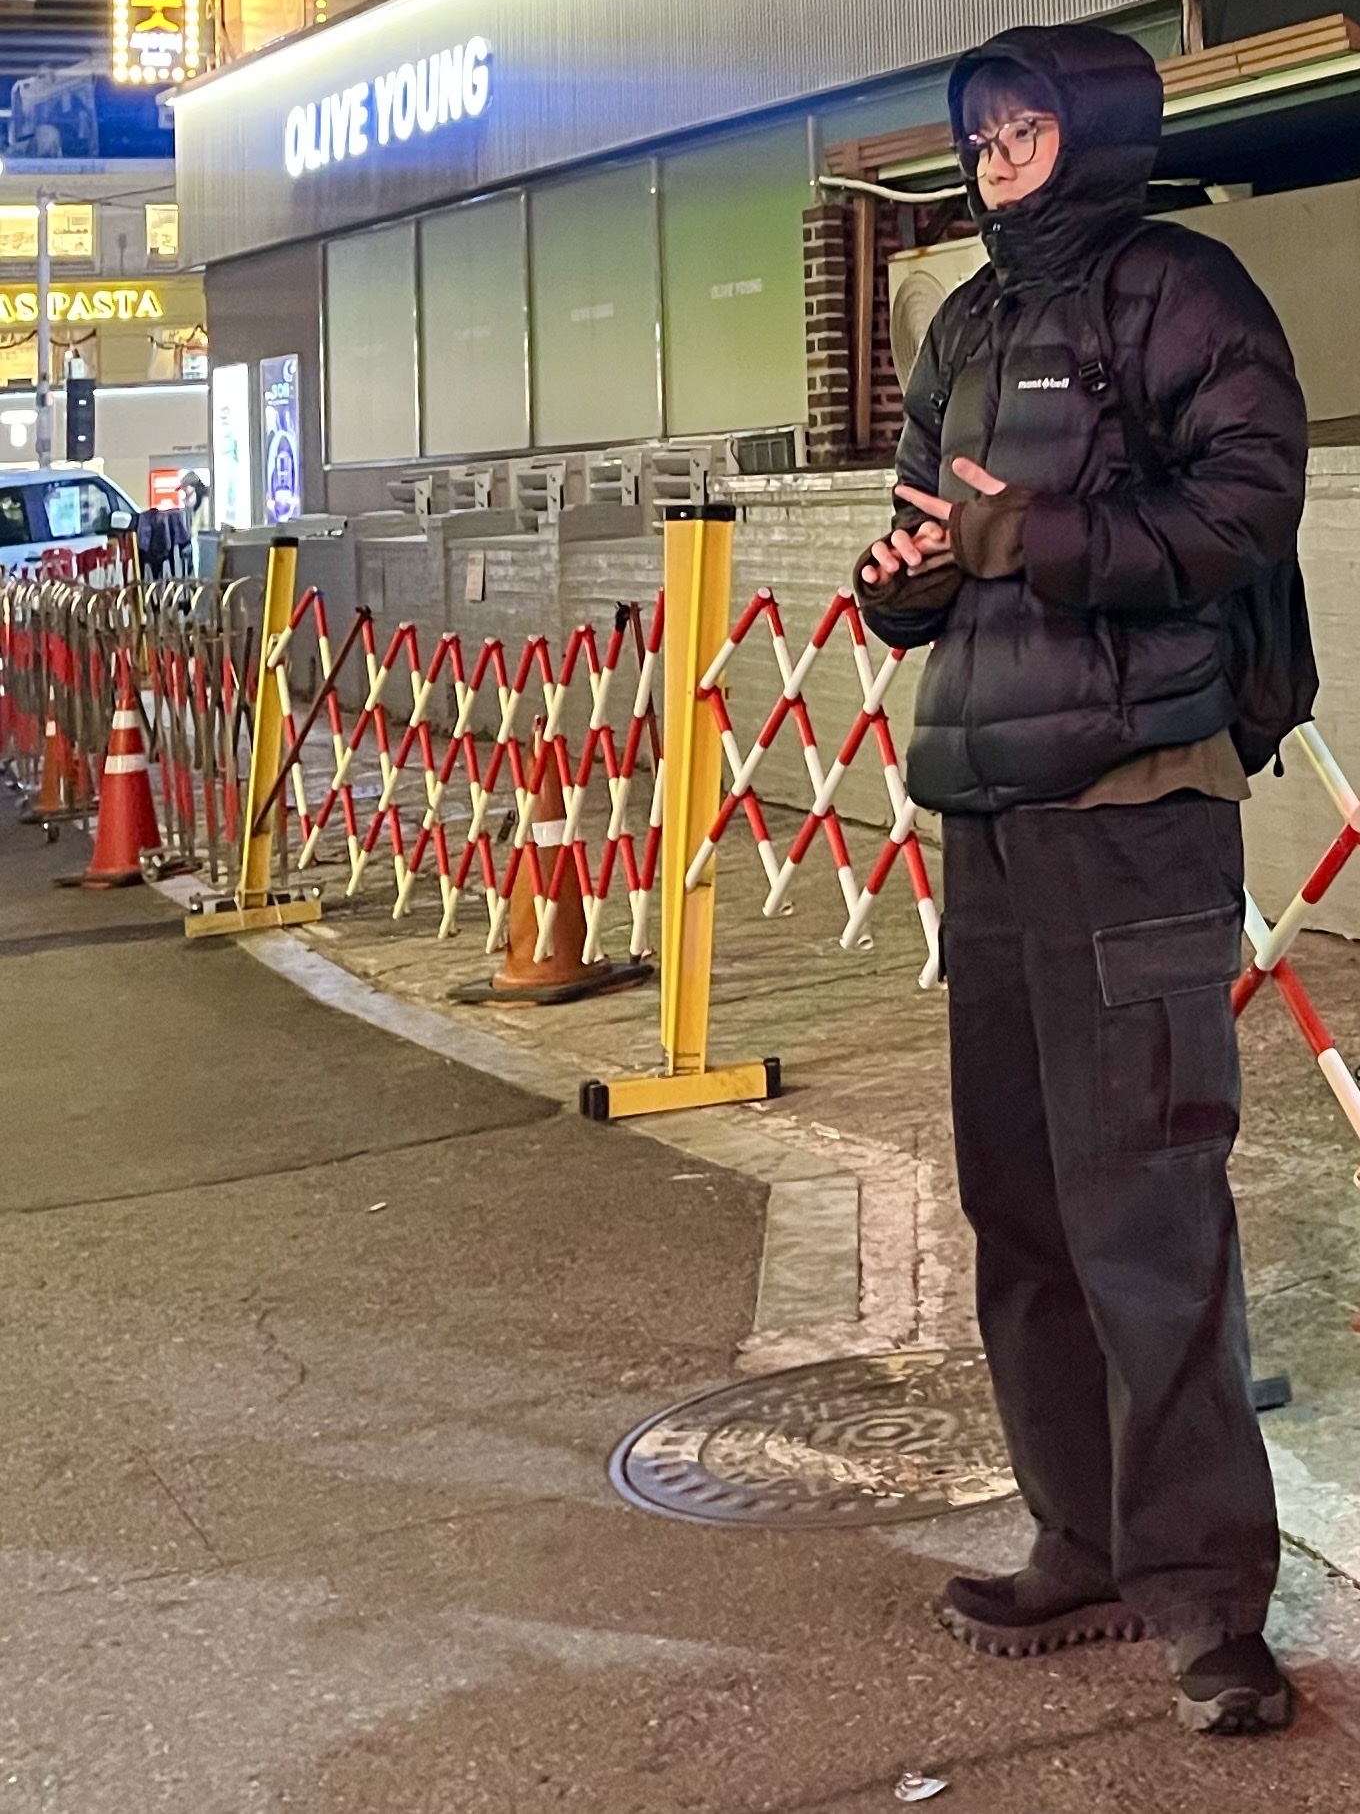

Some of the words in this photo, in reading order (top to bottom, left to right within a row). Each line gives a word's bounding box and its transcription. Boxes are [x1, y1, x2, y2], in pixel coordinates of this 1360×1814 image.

[284, 81, 369, 178] OLIVE
[374, 34, 490, 146] YOUNG
[47, 289, 163, 321] PASTA
